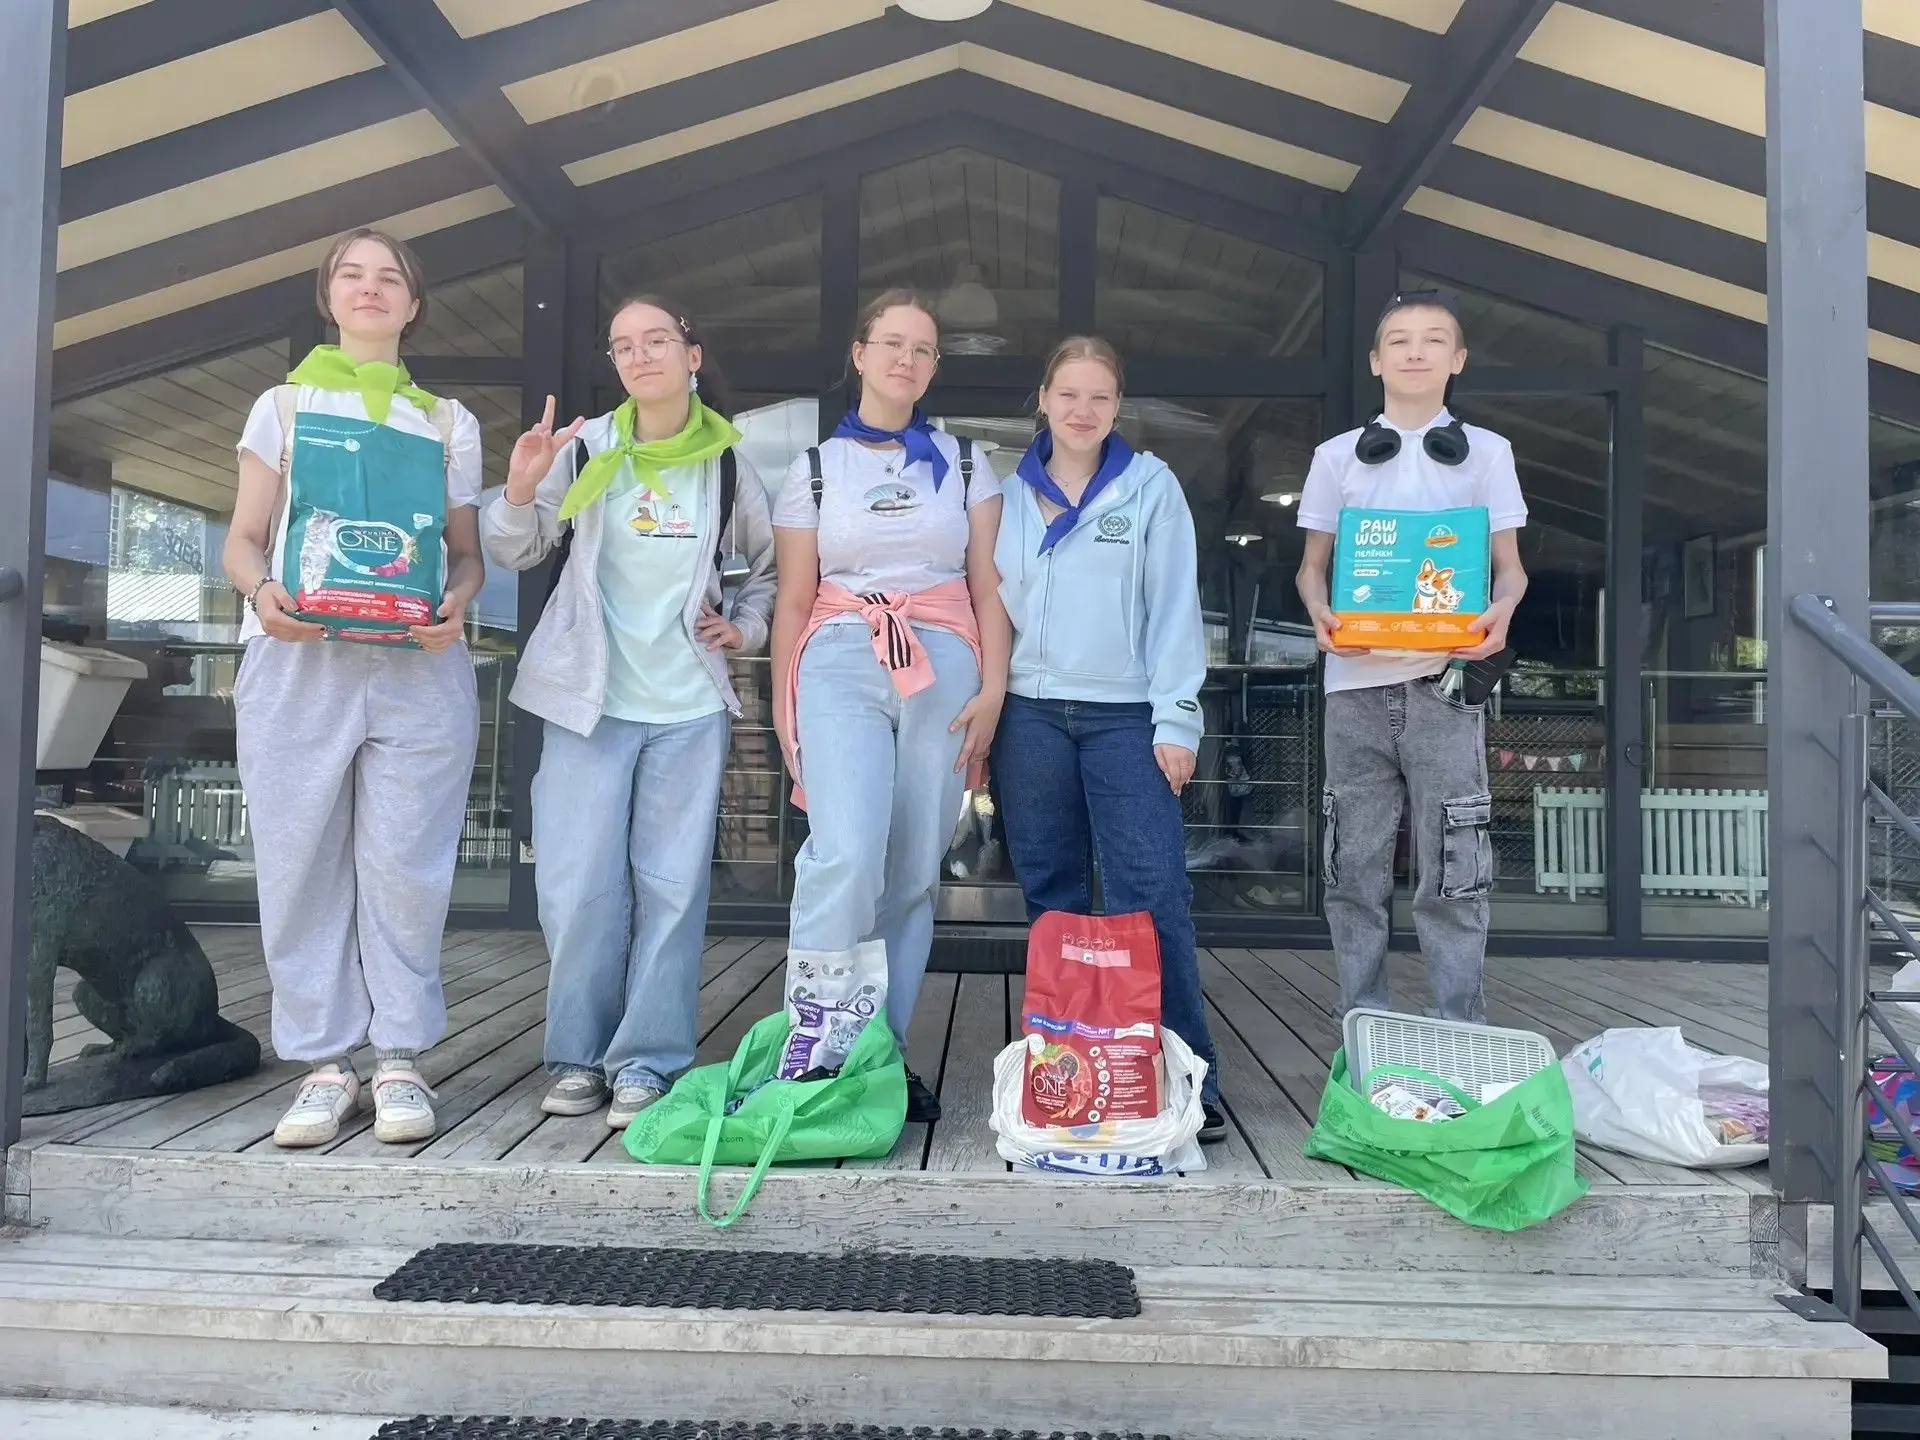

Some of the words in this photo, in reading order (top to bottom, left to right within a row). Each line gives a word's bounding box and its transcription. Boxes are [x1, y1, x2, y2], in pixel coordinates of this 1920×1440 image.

[1360, 519, 1397, 533] PAW
[338, 530, 398, 552] ONE
[1355, 532, 1397, 546] WOW
[1354, 549, 1393, 558] ПЕЛЁНКИ
[1033, 1075, 1067, 1097] ONE
